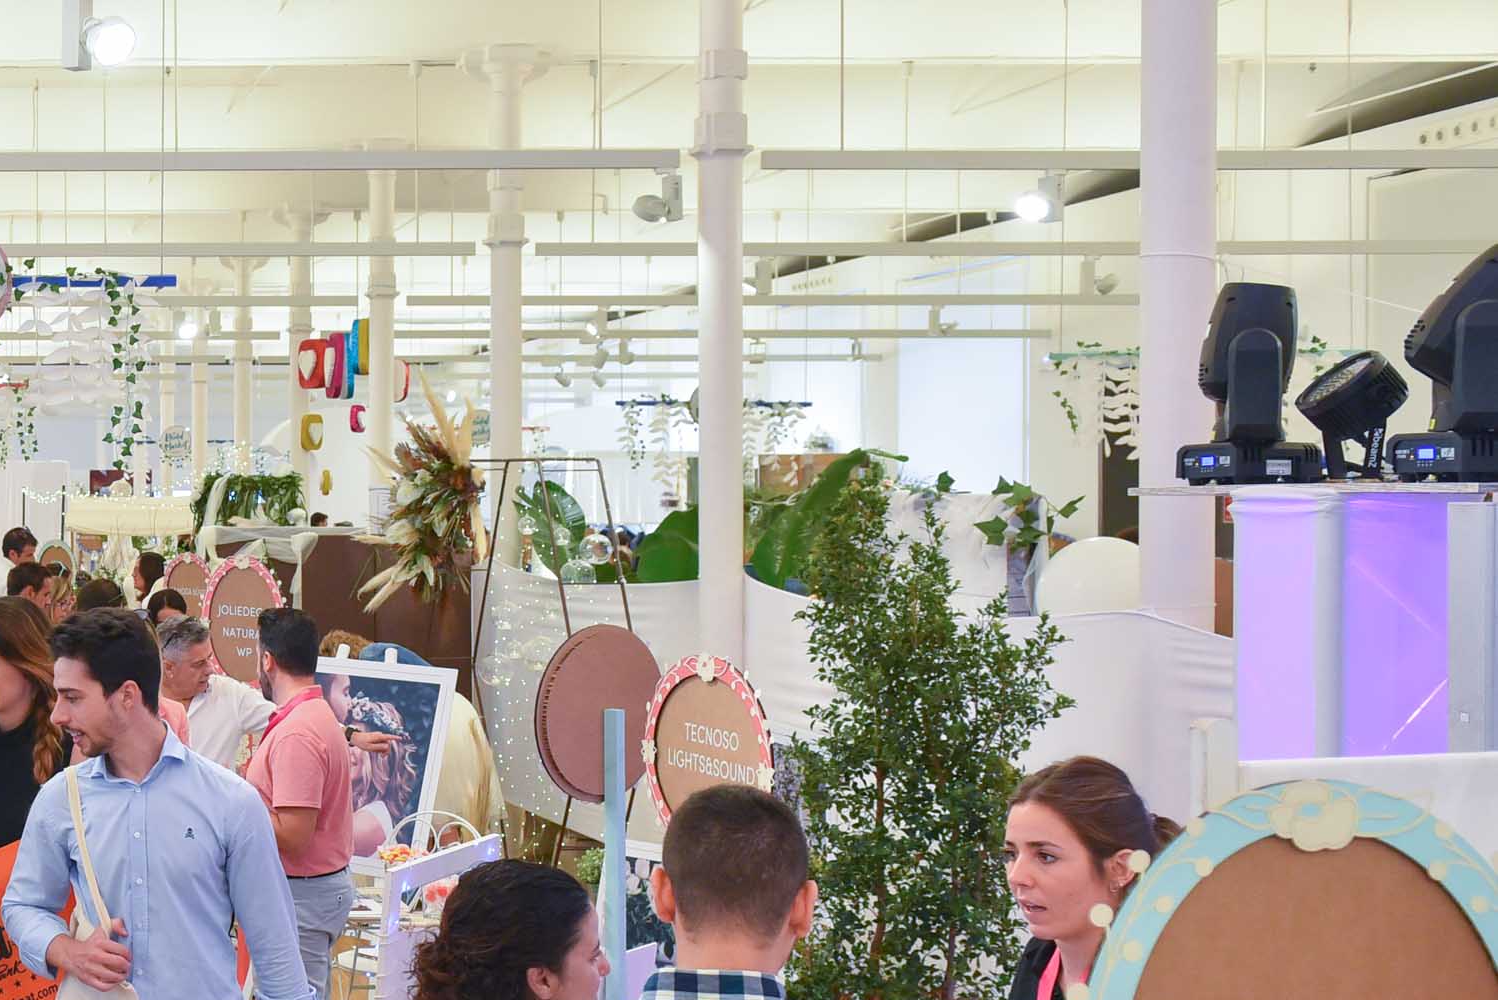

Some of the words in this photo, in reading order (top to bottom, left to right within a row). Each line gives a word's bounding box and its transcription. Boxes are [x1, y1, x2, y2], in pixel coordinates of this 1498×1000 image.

[217, 604, 263, 617] JOLIEDEC
[222, 627, 260, 640] NATURA
[236, 646, 252, 657] WP
[684, 722, 740, 752] TECNOSO
[668, 747, 756, 785] LIGHTS&SOUND
